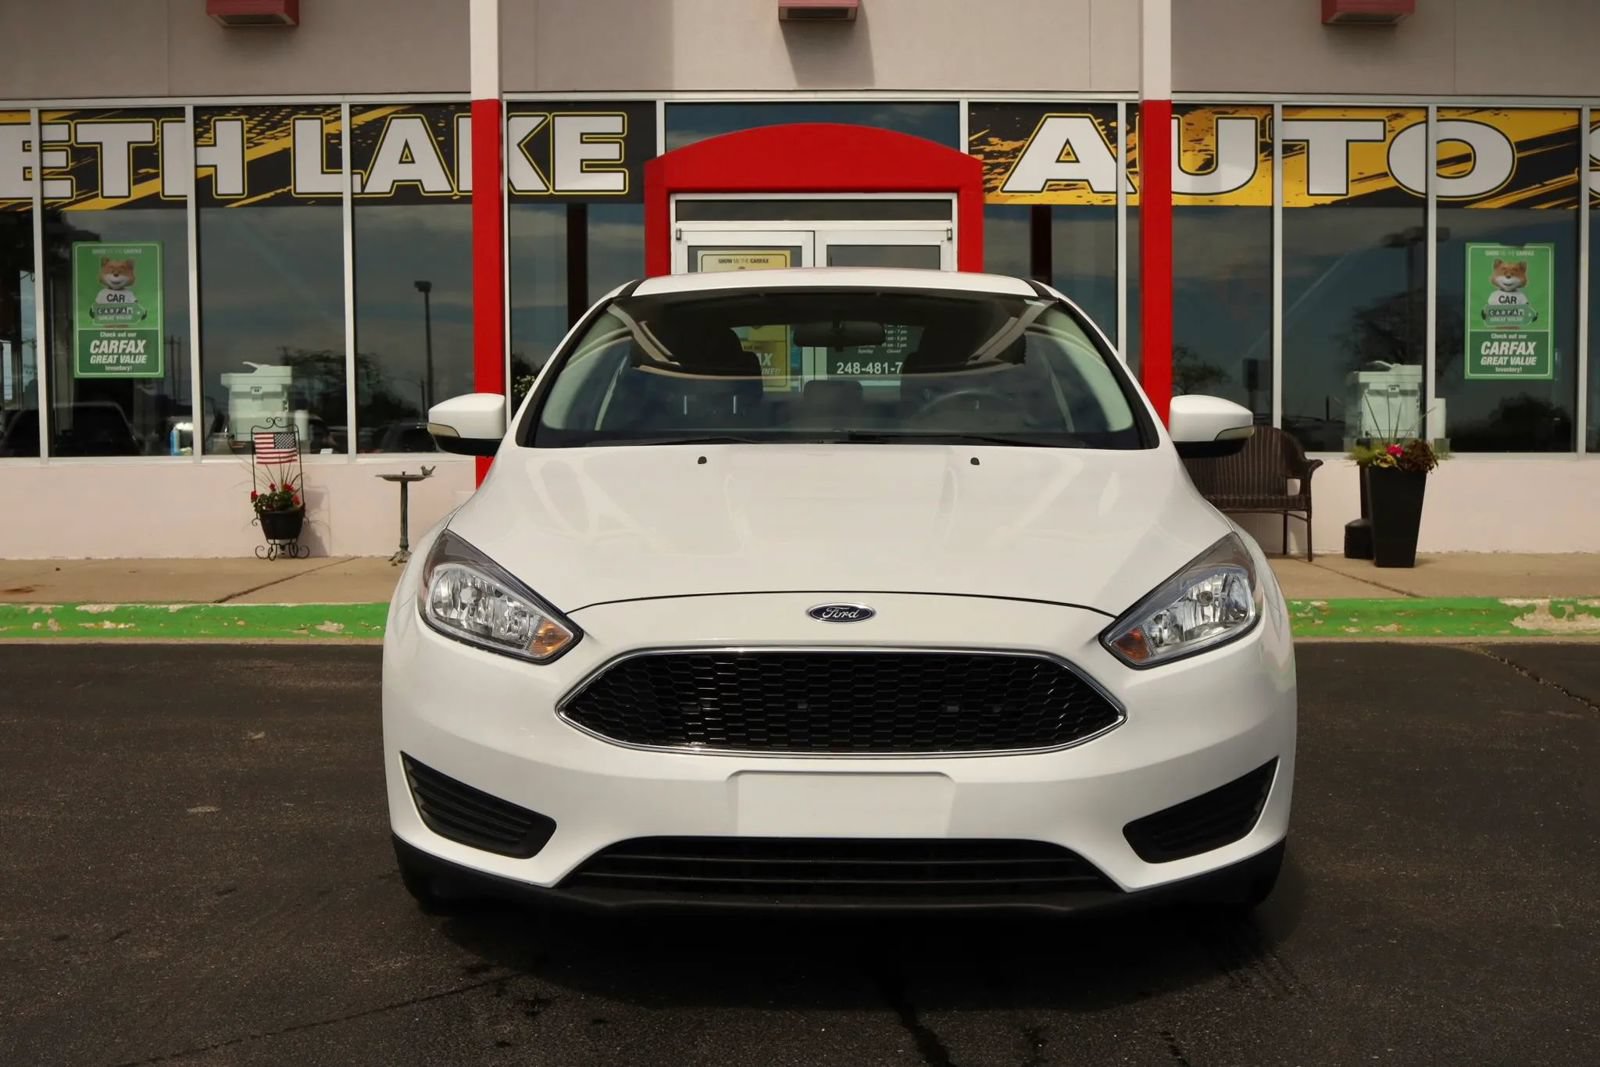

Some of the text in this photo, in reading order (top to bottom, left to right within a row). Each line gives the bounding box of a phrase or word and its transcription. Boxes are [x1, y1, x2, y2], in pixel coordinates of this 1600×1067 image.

[292, 113, 628, 197] LAKE
[1000, 113, 1516, 200] AUTO
[106, 293, 126, 303] CAR
[1498, 295, 1518, 304] CAR
[89, 339, 147, 354] CARFAX
[1480, 341, 1537, 355] CARFAX
[89, 354, 148, 364] GREAT VALUE
[1480, 356, 1537, 366] GREAT VALUE
[836, 361, 903, 375] 248-481-7
[822, 607, 860, 618] Ford
